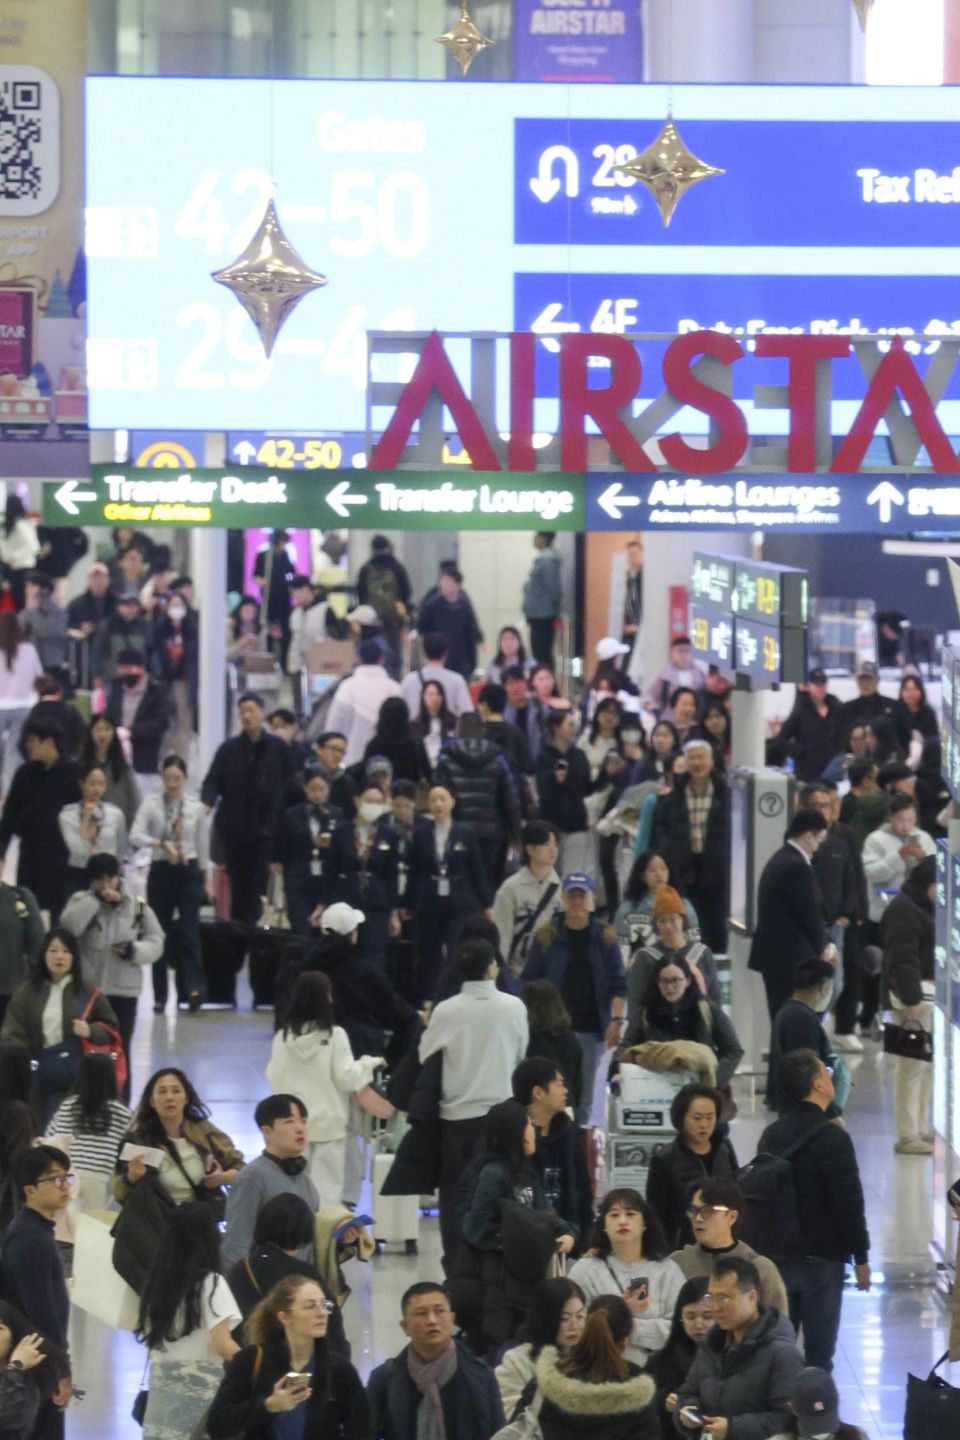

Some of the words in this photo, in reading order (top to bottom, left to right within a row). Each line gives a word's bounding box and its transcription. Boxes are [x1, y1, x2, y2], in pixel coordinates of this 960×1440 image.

[530, 9, 625, 35] AIRSTAR
[315, 110, 427, 154] Gates
[856, 168, 911, 204] Tax
[257, 440, 342, 469] 42-50
[104, 476, 217, 501] Transfer
[220, 478, 288, 504] Desk
[375, 482, 478, 513] Transfer
[480, 485, 575, 520] Lounge
[647, 479, 734, 506] Airline
[735, 480, 841, 513] Lounges
